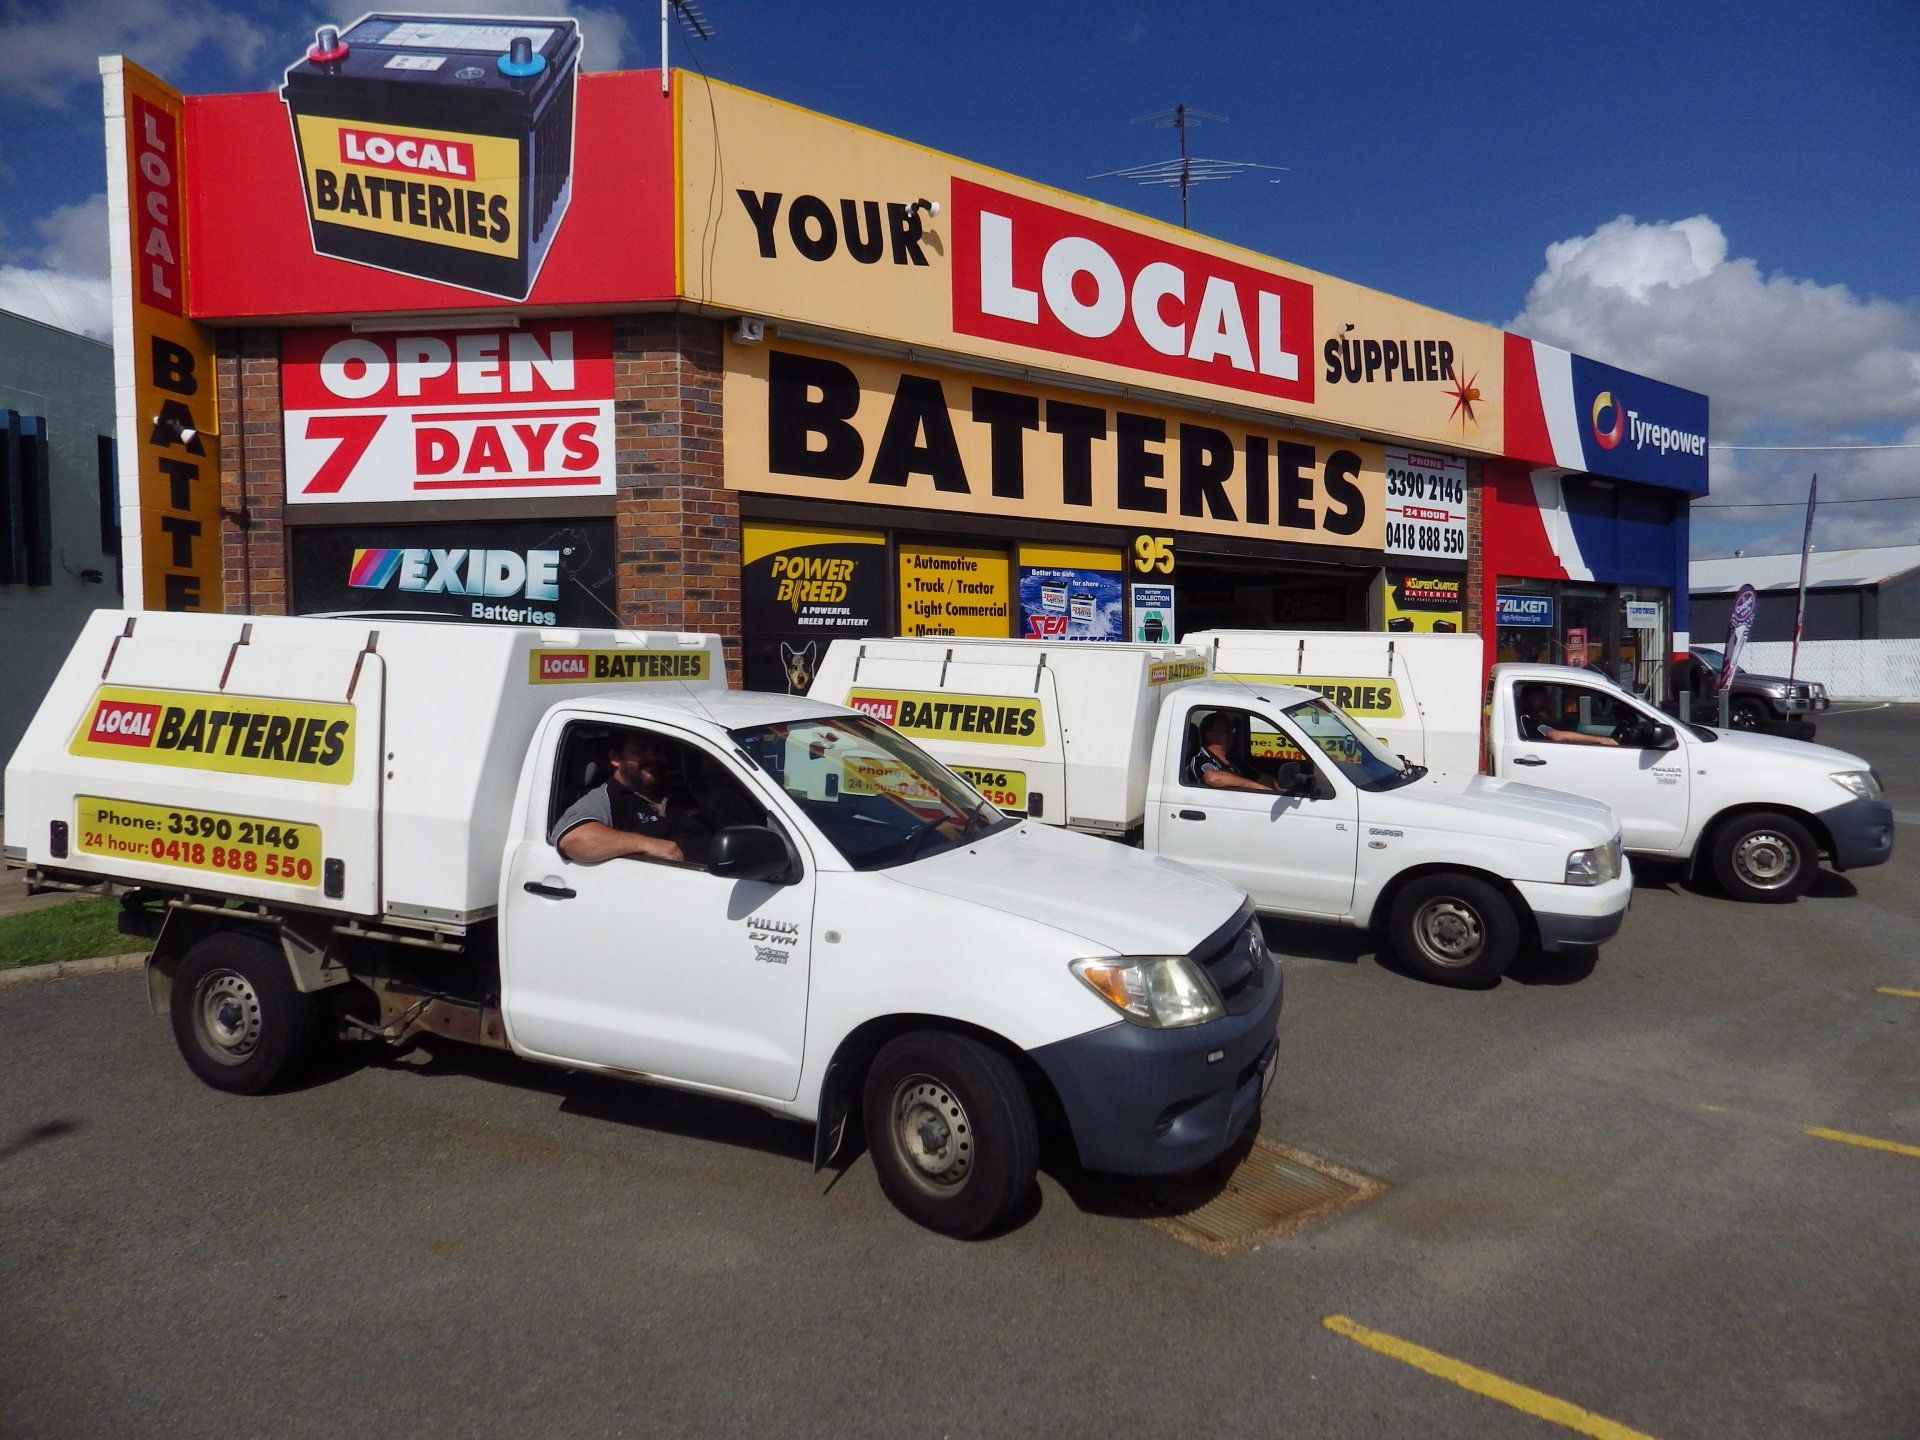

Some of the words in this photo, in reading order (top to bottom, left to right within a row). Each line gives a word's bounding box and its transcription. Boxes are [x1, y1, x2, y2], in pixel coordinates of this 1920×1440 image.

[346, 134, 468, 176] LOCAL
[141, 112, 176, 299] LOCAL
[315, 169, 511, 245] BATTERIES
[736, 189, 930, 267] YOUR
[979, 210, 1299, 382] LOCAL
[320, 331, 575, 400] OPEN
[1324, 339, 1456, 384] SUPPLIER
[768, 350, 1366, 537] BATTERIES
[1627, 410, 1706, 457] Tyrepower
[302, 415, 388, 494] 7
[414, 421, 600, 475] DAYS
[1410, 456, 1442, 469] PHONE
[1387, 468, 1425, 499] 3390
[1428, 474, 1463, 505] 2146
[1405, 508, 1417, 517] 24
[1420, 509, 1446, 520] HOUR
[1386, 522, 1415, 550] 0418
[1419, 525, 1440, 552] 888
[1444, 528, 1464, 554] 550
[914, 555, 978, 572] Automotive
[1135, 535, 1175, 574] 95
[399, 548, 560, 602] EXIDE
[771, 556, 855, 581] POWER
[1031, 569, 1051, 577] Better
[1052, 569, 1061, 577] be
[777, 579, 848, 608] BREED
[914, 578, 944, 593] Truck
[947, 579, 954, 595] /
[957, 580, 994, 595] Tractor
[1083, 580, 1099, 588] shore
[1405, 590, 1458, 598] BATTERIES
[809, 607, 851, 615] POWERFUL
[914, 600, 942, 618] Light
[946, 602, 1007, 617] Commercial
[1136, 594, 1170, 602] COLLECTION
[471, 602, 557, 626] Batteries
[798, 618, 824, 626] BREED
[825, 618, 835, 626] OF
[1025, 615, 1069, 639] SEA
[916, 623, 955, 637] Marine
[543, 660, 586, 673] LOCAL
[595, 655, 701, 678] BATTERIES
[1293, 684, 1392, 710] ERIES
[899, 701, 1037, 737] BATTERIES
[96, 708, 151, 737] LOCAL
[156, 706, 349, 766] BATTERIES
[97, 810, 162, 831] Phone:
[167, 813, 232, 840] 3390
[238, 822, 299, 850] 2146
[1336, 823, 1348, 831] GL
[84, 832, 103, 847] 24
[108, 835, 148, 854] hour:
[151, 838, 205, 865] 0418
[212, 847, 257, 872] 888
[265, 854, 313, 880] 550
[746, 916, 800, 936] HILUX
